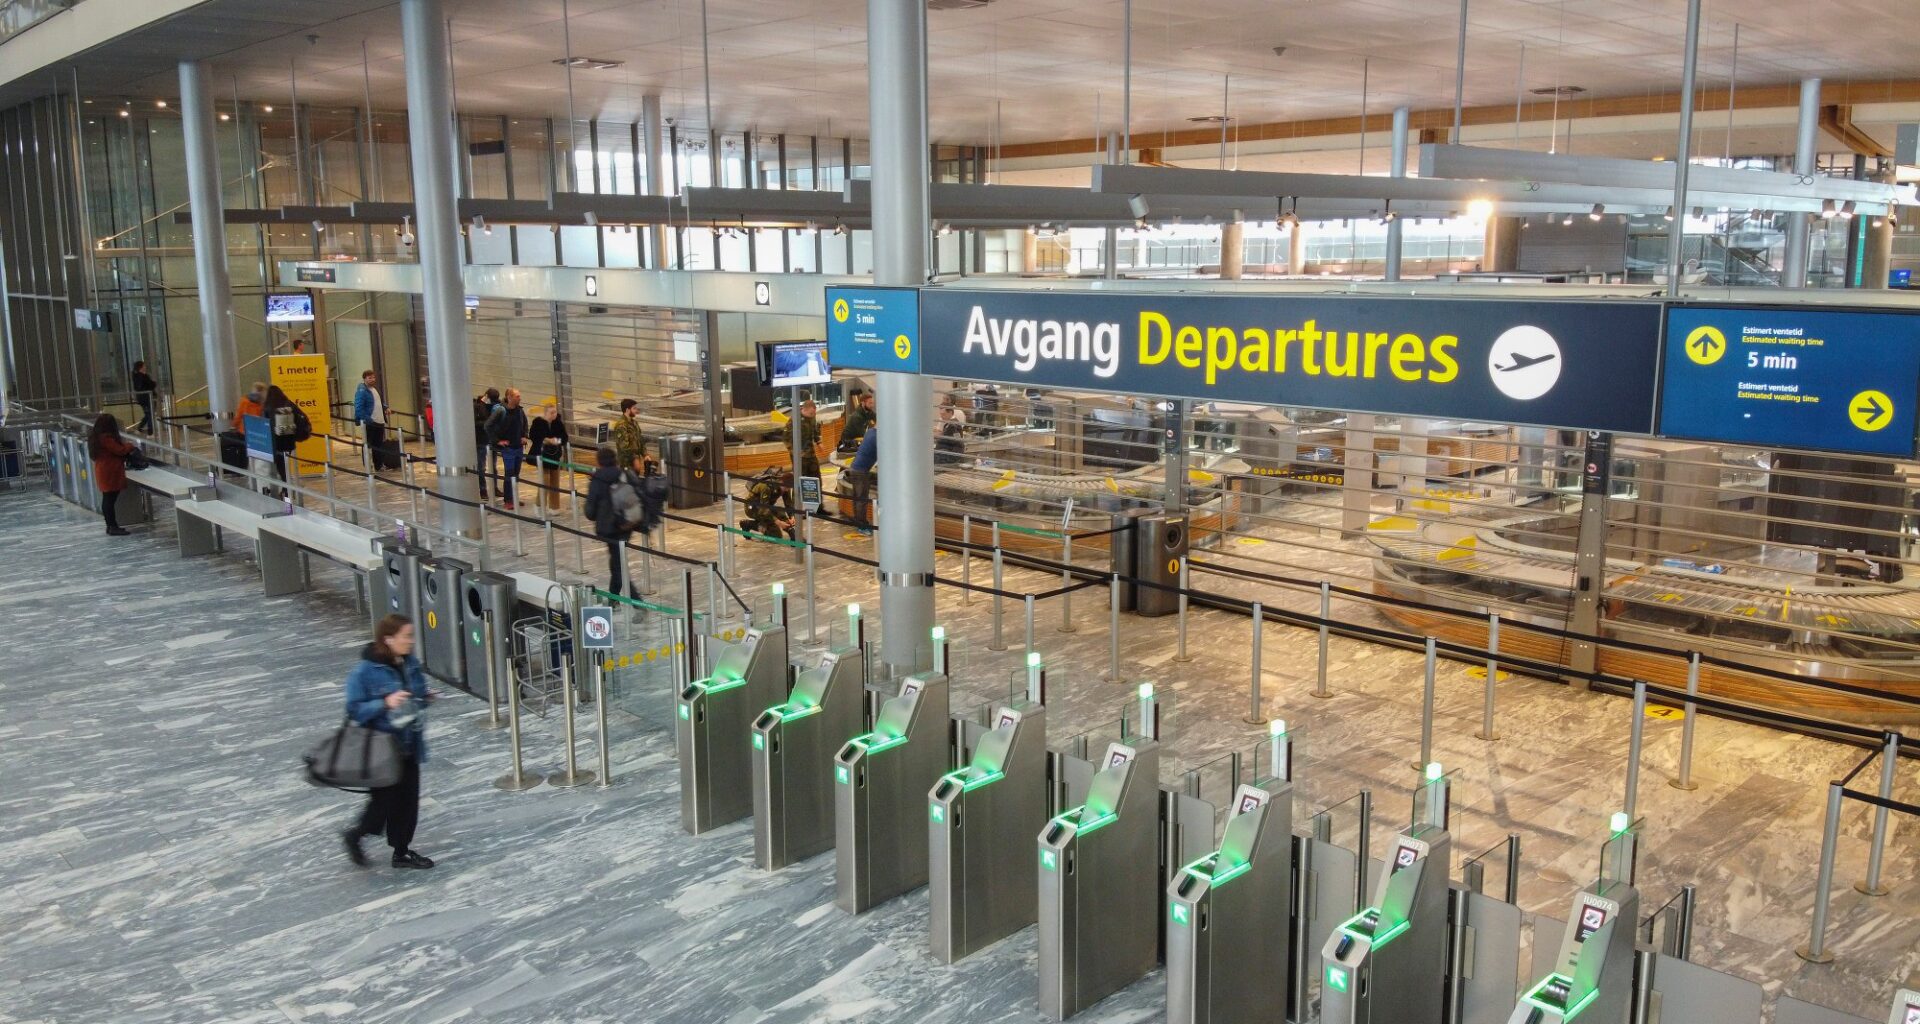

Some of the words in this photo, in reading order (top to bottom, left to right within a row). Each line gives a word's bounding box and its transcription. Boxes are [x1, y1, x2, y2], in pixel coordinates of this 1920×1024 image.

[857, 313, 862, 324] 5
[862, 314, 875, 324] min
[1742, 326, 1772, 335] Estimert
[1773, 327, 1803, 336] ventetid
[962, 304, 1121, 378] Avgang
[1138, 311, 1460, 386] Departures
[1742, 335, 1777, 344] Estimated
[1778, 337, 1806, 346] waiting
[1807, 338, 1824, 346] time
[1747, 351, 1759, 368] 5
[1763, 352, 1798, 370] min
[278, 366, 284, 375] 1
[287, 367, 317, 375] meter
[1738, 381, 1768, 391] Estimert
[1768, 384, 1798, 393] ventetid
[1737, 391, 1773, 400] Estimated
[1773, 393, 1801, 403] waiting
[1802, 395, 1820, 403] time
[295, 399, 317, 408] feet
